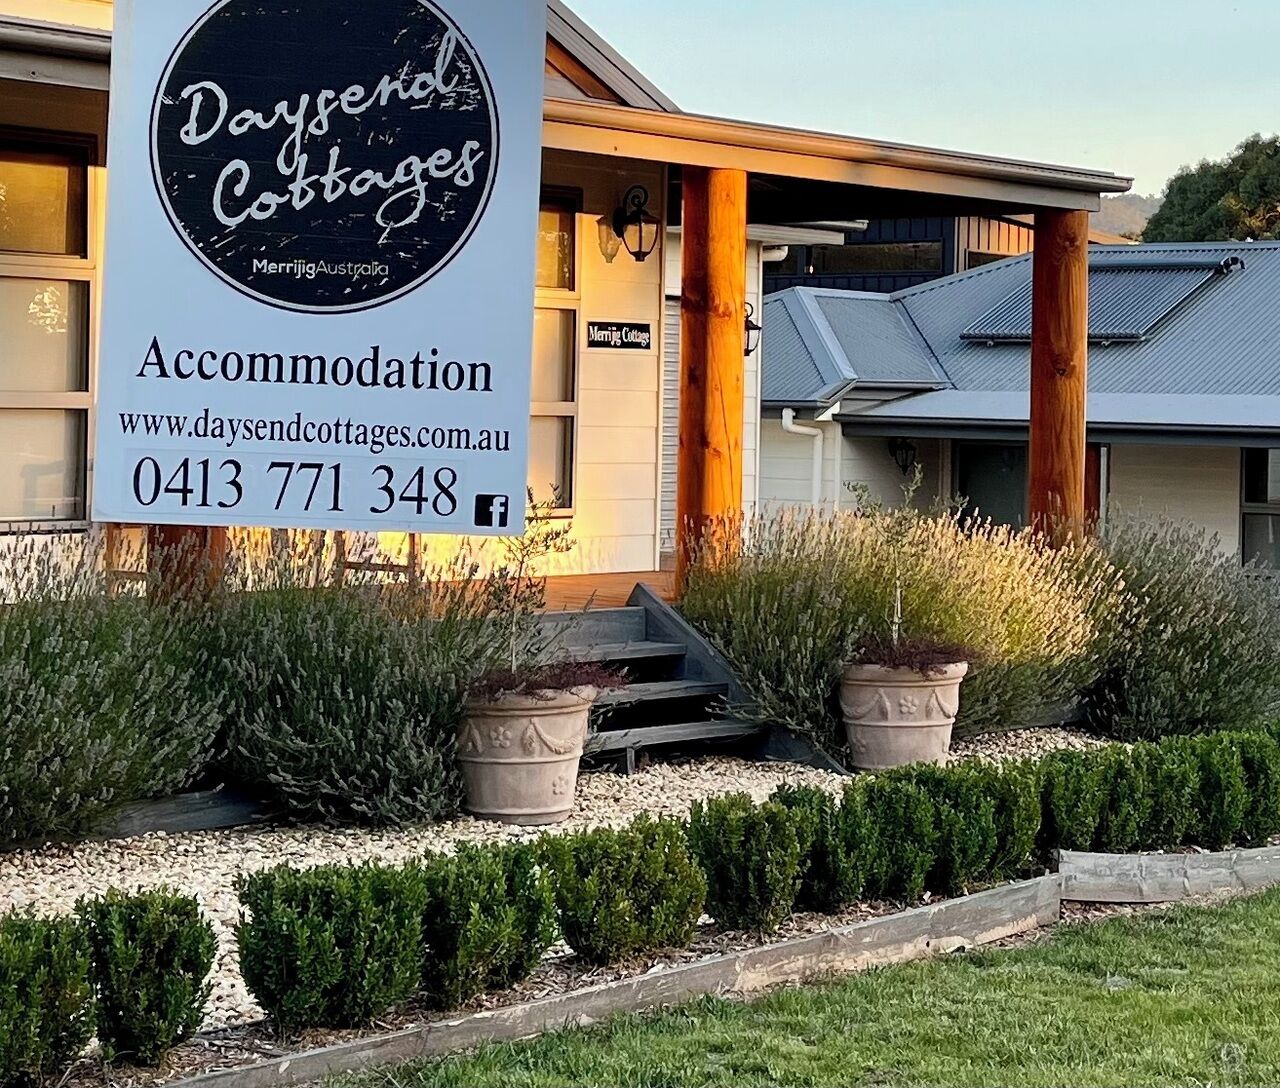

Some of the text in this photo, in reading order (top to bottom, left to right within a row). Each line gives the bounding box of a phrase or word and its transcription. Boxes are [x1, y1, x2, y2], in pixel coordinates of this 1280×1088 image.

[179, 28, 457, 174] Daysend
[213, 137, 484, 232] Cottages
[136, 336, 493, 392] Accommodation
[622, 327, 649, 347] Cottage
[119, 409, 510, 453] www.daysendcottages.com.au
[132, 457, 458, 516] 0413 771 348
